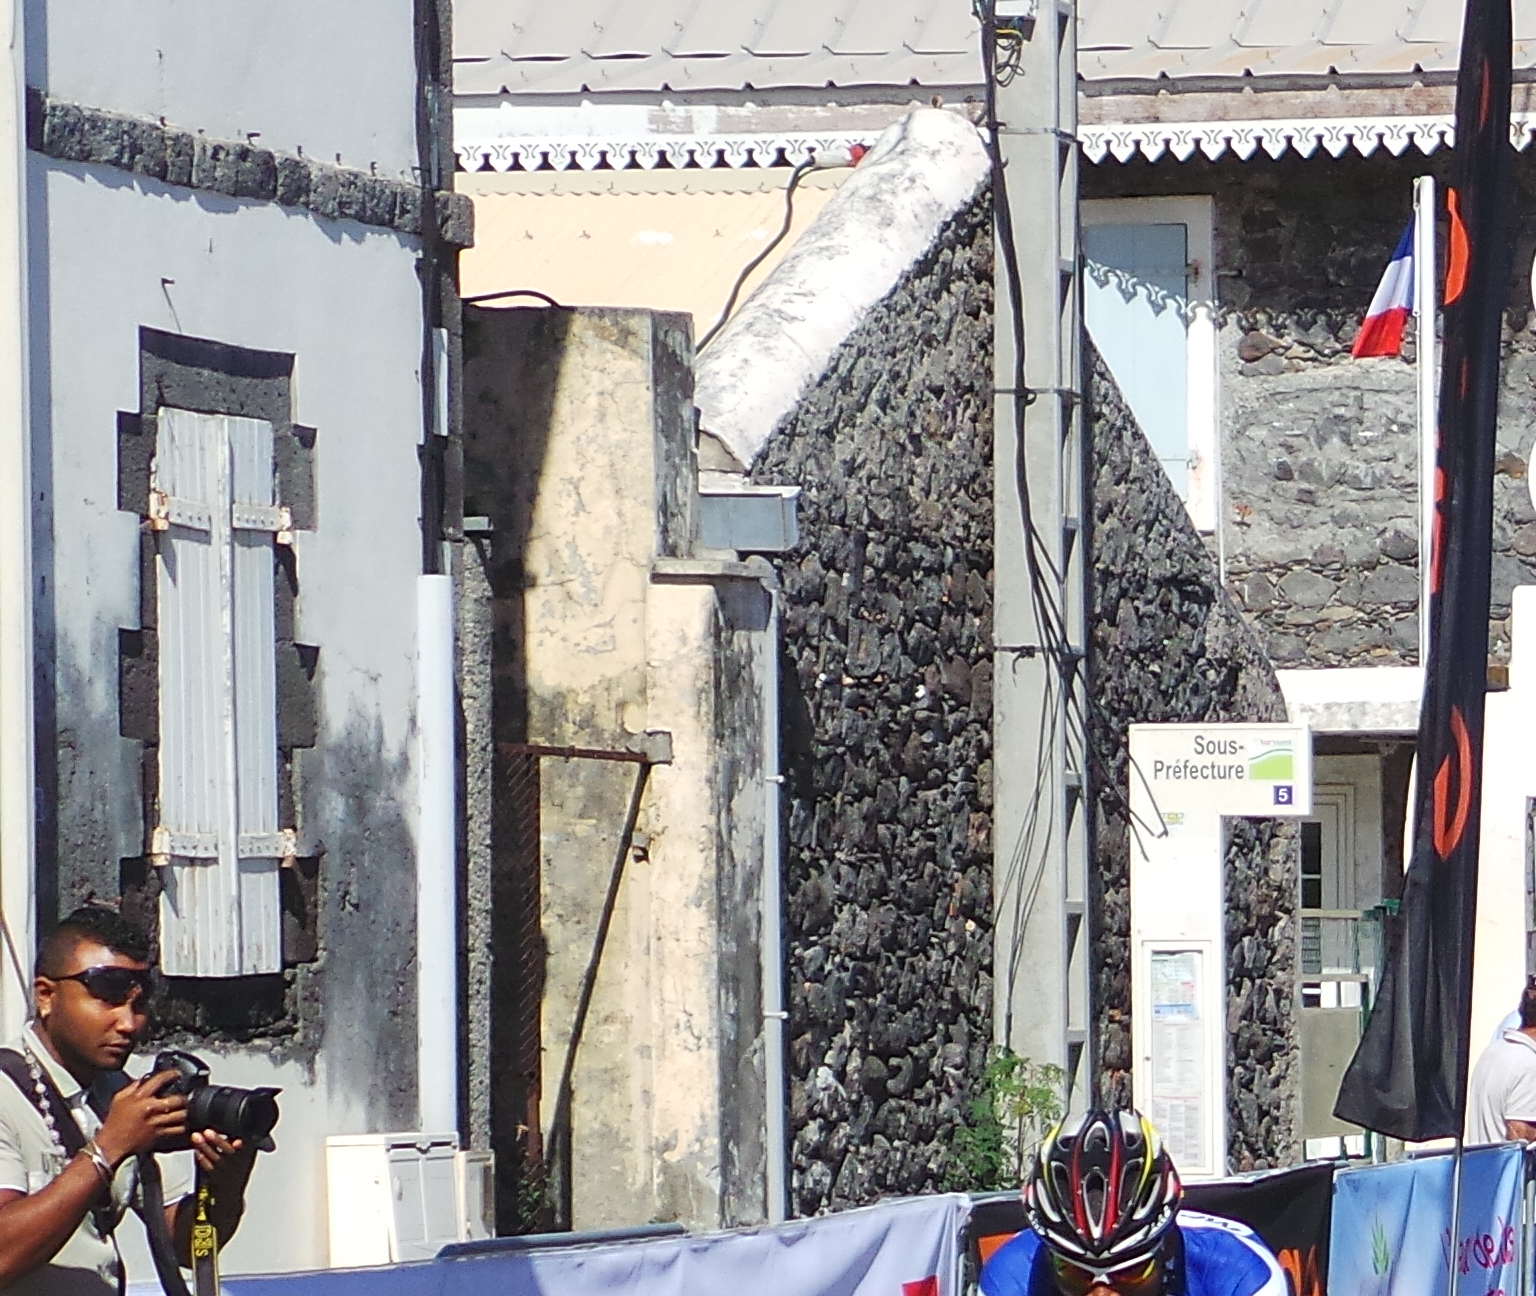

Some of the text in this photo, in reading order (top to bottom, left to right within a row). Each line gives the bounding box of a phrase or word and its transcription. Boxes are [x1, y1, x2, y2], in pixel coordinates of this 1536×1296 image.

[1193, 734, 1245, 755] Sous-
[1153, 759, 1244, 780] Préfecture
[1278, 787, 1288, 802] 5
